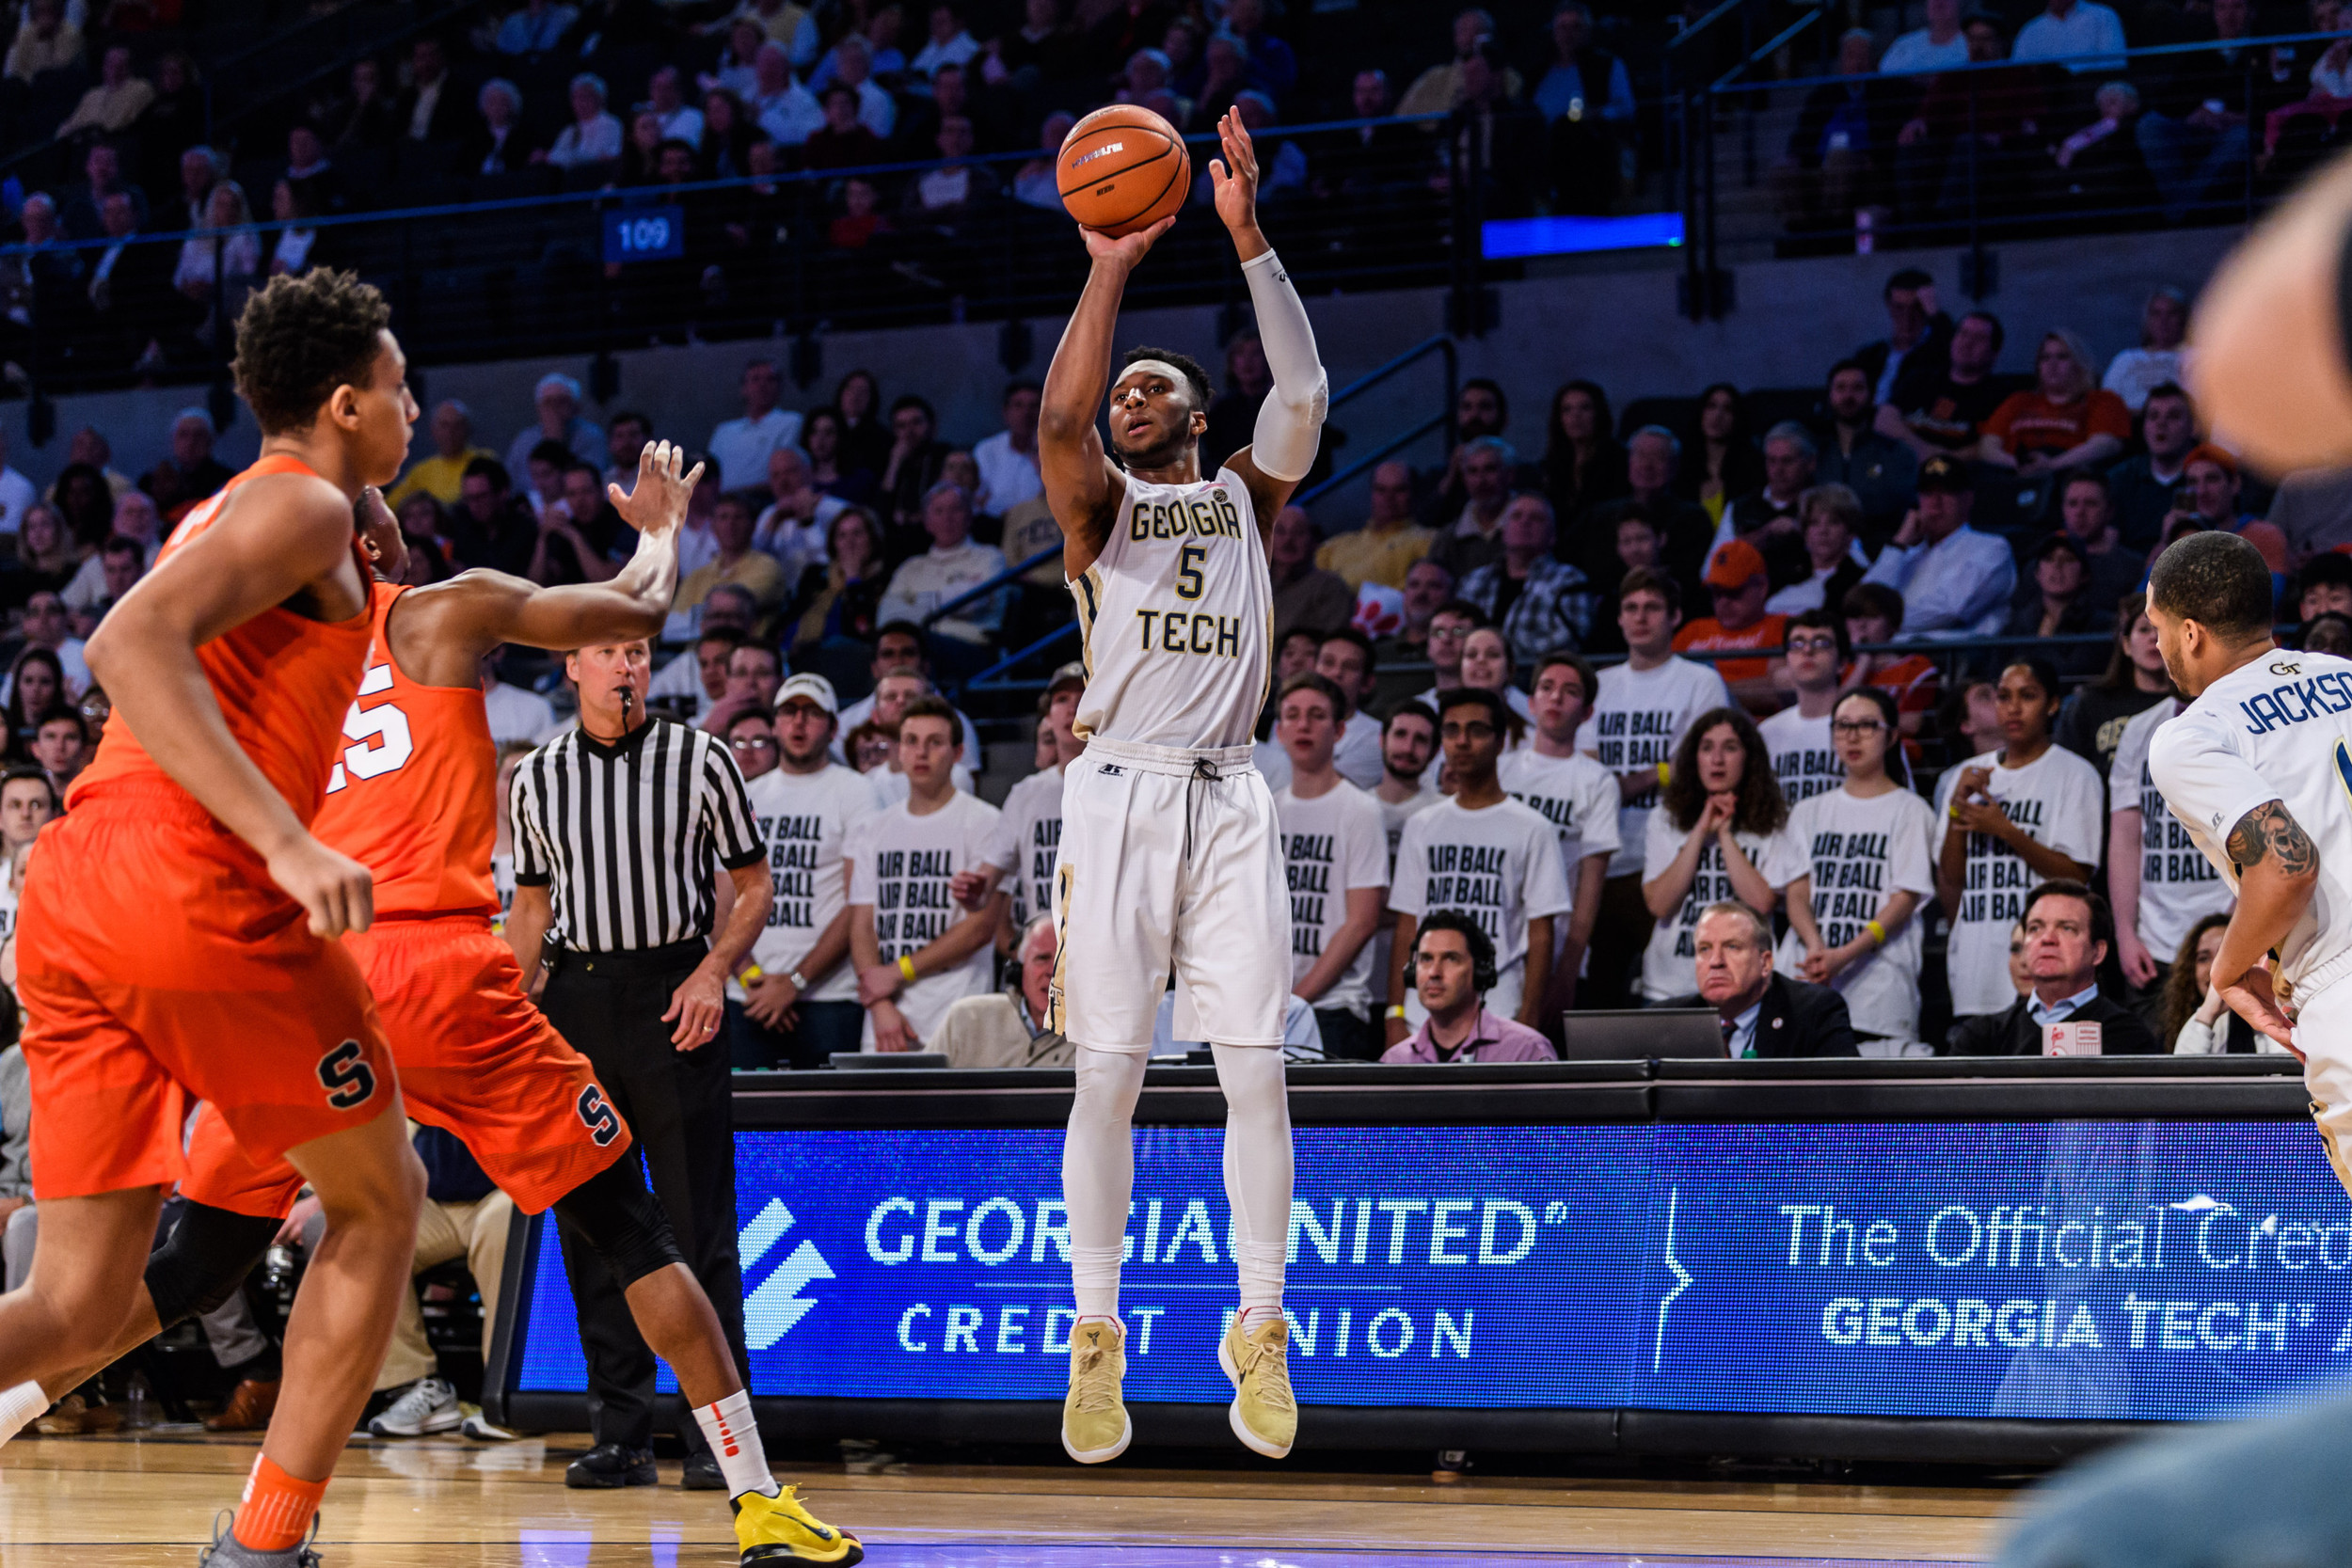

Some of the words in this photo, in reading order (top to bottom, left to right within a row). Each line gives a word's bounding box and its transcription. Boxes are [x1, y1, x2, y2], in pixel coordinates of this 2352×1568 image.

[618, 217, 669, 251] 109
[1131, 499, 1243, 543] GEOGIA
[1176, 546, 1207, 601] 5
[1136, 610, 1240, 658] TECH
[326, 663, 414, 795] 5
[1630, 711, 1672, 736] BALL
[1629, 739, 1670, 765] BALL
[777, 816, 821, 841] BALL
[772, 845, 818, 869] BALL
[1289, 834, 1334, 863] BALL
[1846, 832, 1887, 860] BALL
[877, 851, 903, 878] AIR
[909, 850, 953, 878] BALL
[1459, 846, 1506, 876] BALL
[2168, 853, 2219, 881] BALL
[1287, 864, 1329, 893] BALL
[1455, 877, 1502, 906] BALL
[1838, 862, 1883, 892] BALL
[906, 881, 951, 909] BALL
[1832, 893, 1878, 921] BALL
[1992, 894, 2020, 920] BA
[768, 901, 814, 928] BALL
[901, 913, 947, 940] BALL
[316, 1038, 375, 1110] S
[577, 1084, 621, 1147] S
[865, 1197, 1219, 1265] GEORIA
[1229, 1198, 1536, 1265] NITED
[1781, 1205, 1897, 1266] The
[1927, 1205, 2164, 1268] Official
[898, 1303, 1165, 1354] CREDT
[1821, 1297, 2104, 1349] GEORGIA
